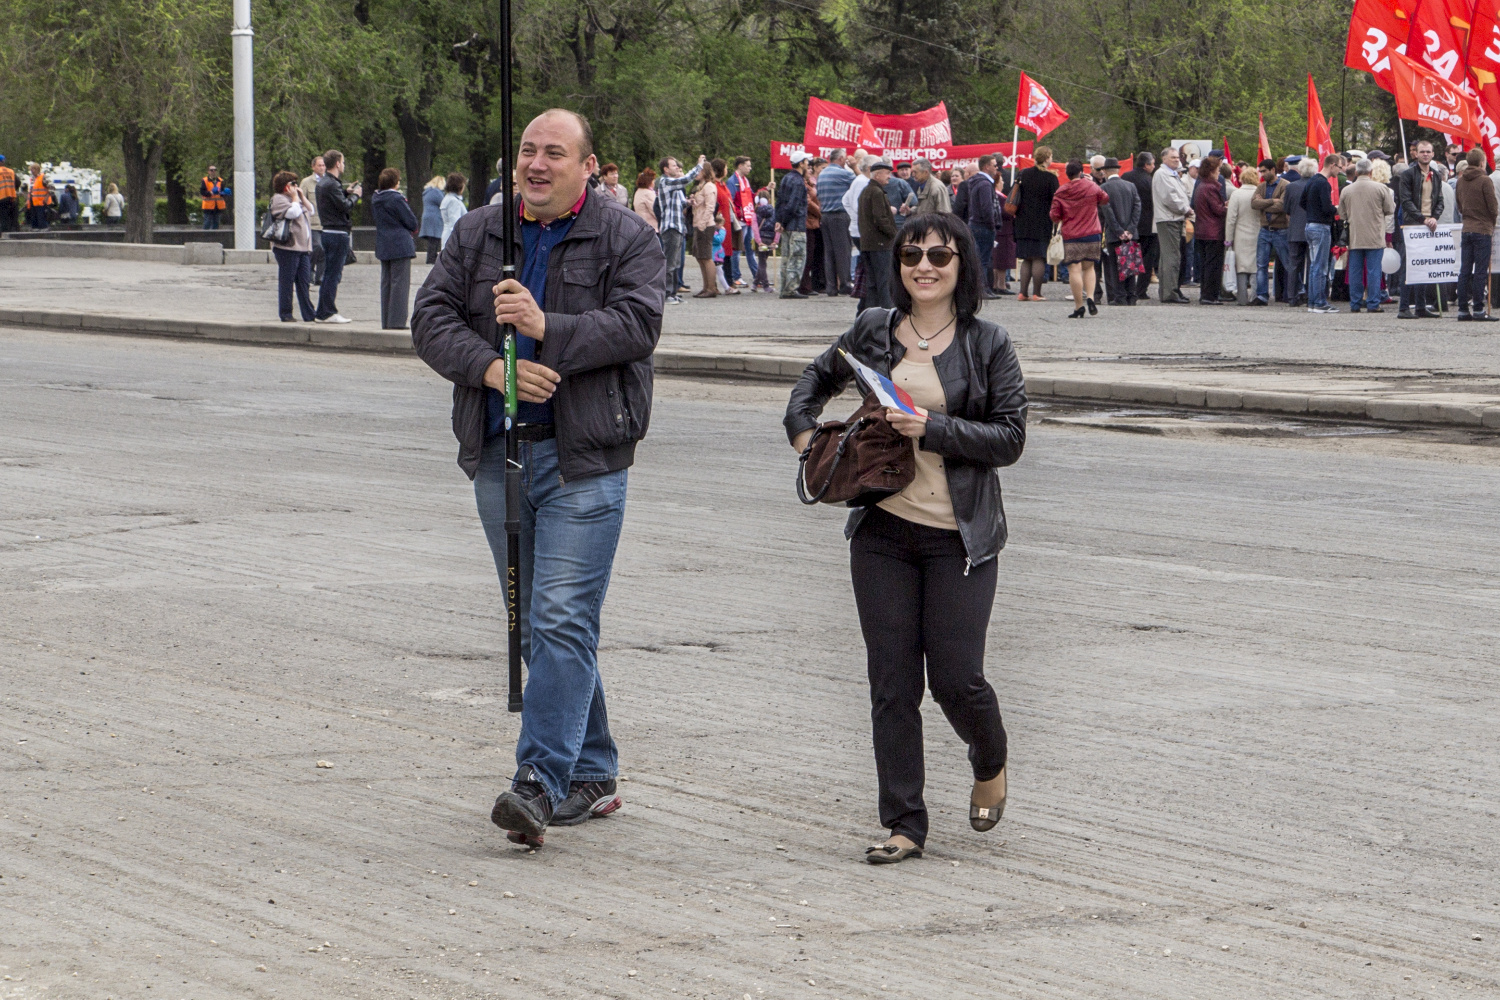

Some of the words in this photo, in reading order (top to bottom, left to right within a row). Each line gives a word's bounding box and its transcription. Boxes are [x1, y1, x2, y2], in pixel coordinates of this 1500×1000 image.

[1417, 102, 1464, 127] КПРФ
[882, 147, 948, 161] РАВЕНСТВО
[1409, 231, 1453, 239] СОВРЕМЕННО
